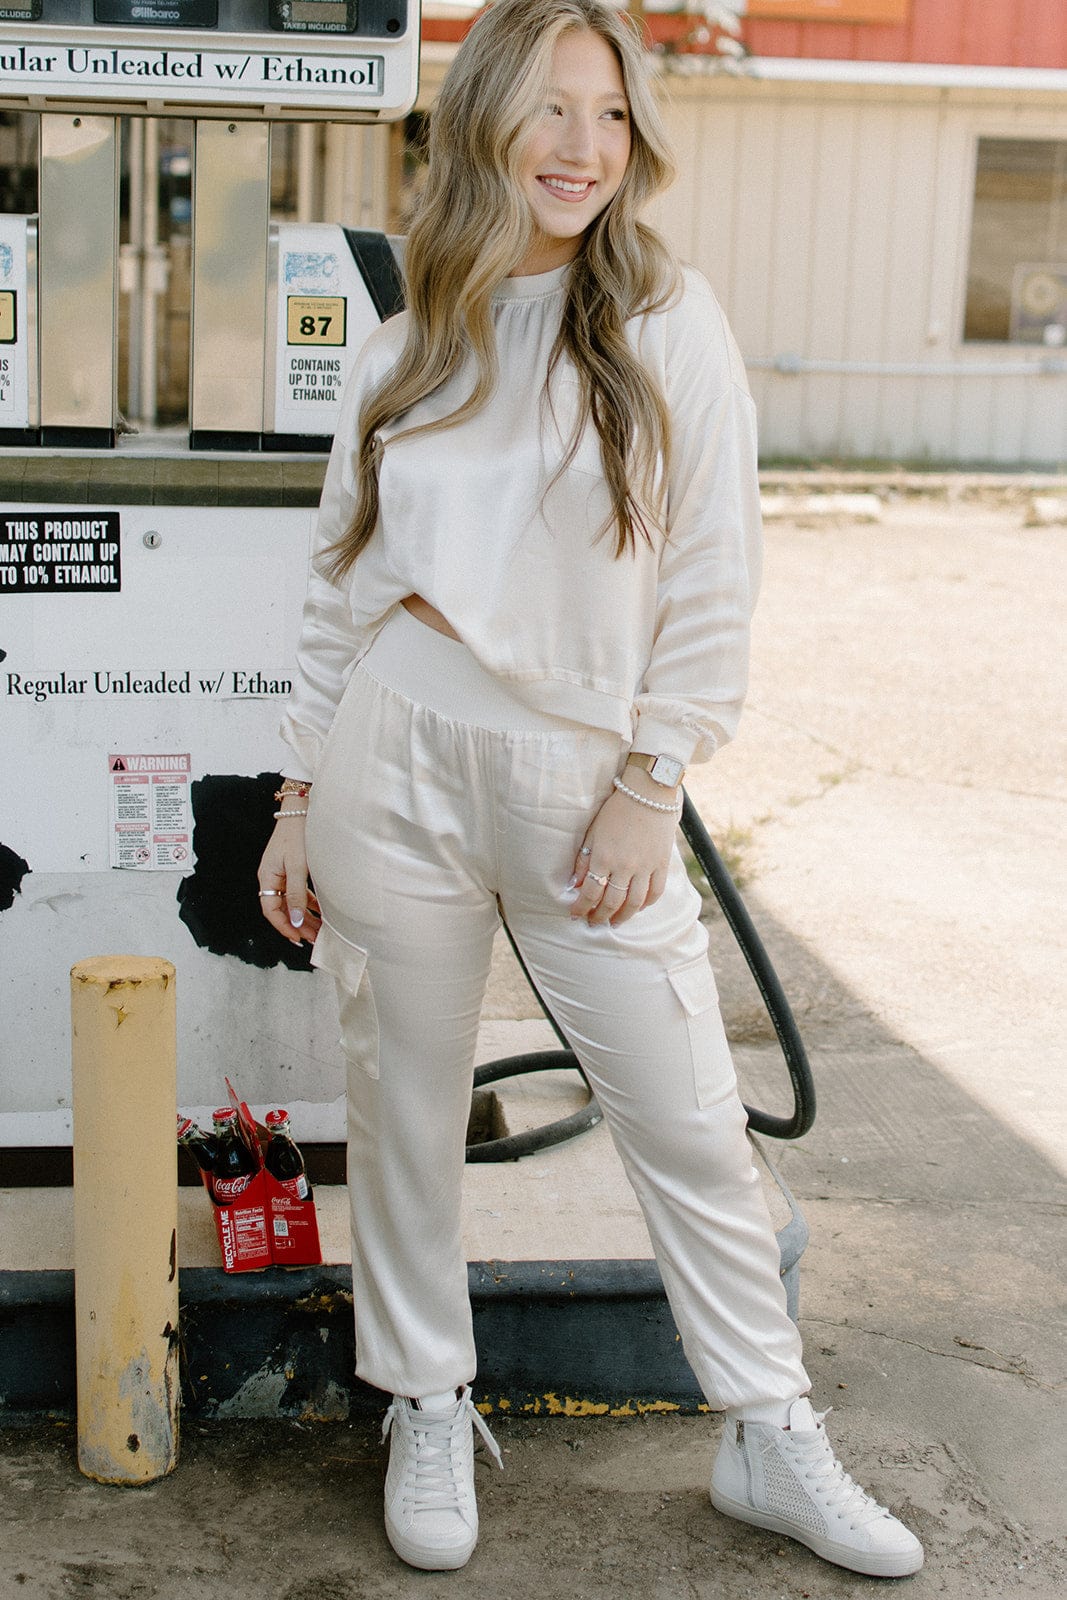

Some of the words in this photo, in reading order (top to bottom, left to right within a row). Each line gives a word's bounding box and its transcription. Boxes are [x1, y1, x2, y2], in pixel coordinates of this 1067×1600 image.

[131, 7, 180, 19] Gilbarco
[283, 22, 306, 30] TAXES
[308, 23, 347, 32] INCLUDED
[66, 48, 203, 78] Unleaded
[214, 56, 251, 80] w/
[261, 57, 376, 86] Ethanol
[300, 315, 332, 336] 87
[291, 358, 341, 371] CONTAINS
[289, 374, 302, 386] UP
[305, 374, 317, 386] TO
[321, 374, 342, 387] 10%
[293, 388, 337, 401] ETHANOL
[5, 521, 39, 540] THIS
[44, 521, 109, 540] PRODUCT
[0, 543, 27, 562] MAY
[33, 543, 94, 562] CONTAIN
[100, 542, 118, 561] UP
[0, 566, 17, 585] TO
[22, 565, 49, 585] 10%
[54, 565, 118, 584] ETHANOL
[6, 672, 88, 702] Regular
[94, 671, 191, 695] Unleaded
[199, 671, 225, 694] w/
[231, 671, 293, 695] Ethan
[127, 756, 188, 770] WARNING
[220, 1210, 230, 1226] ME
[223, 1227, 235, 1269] RECYCLE
